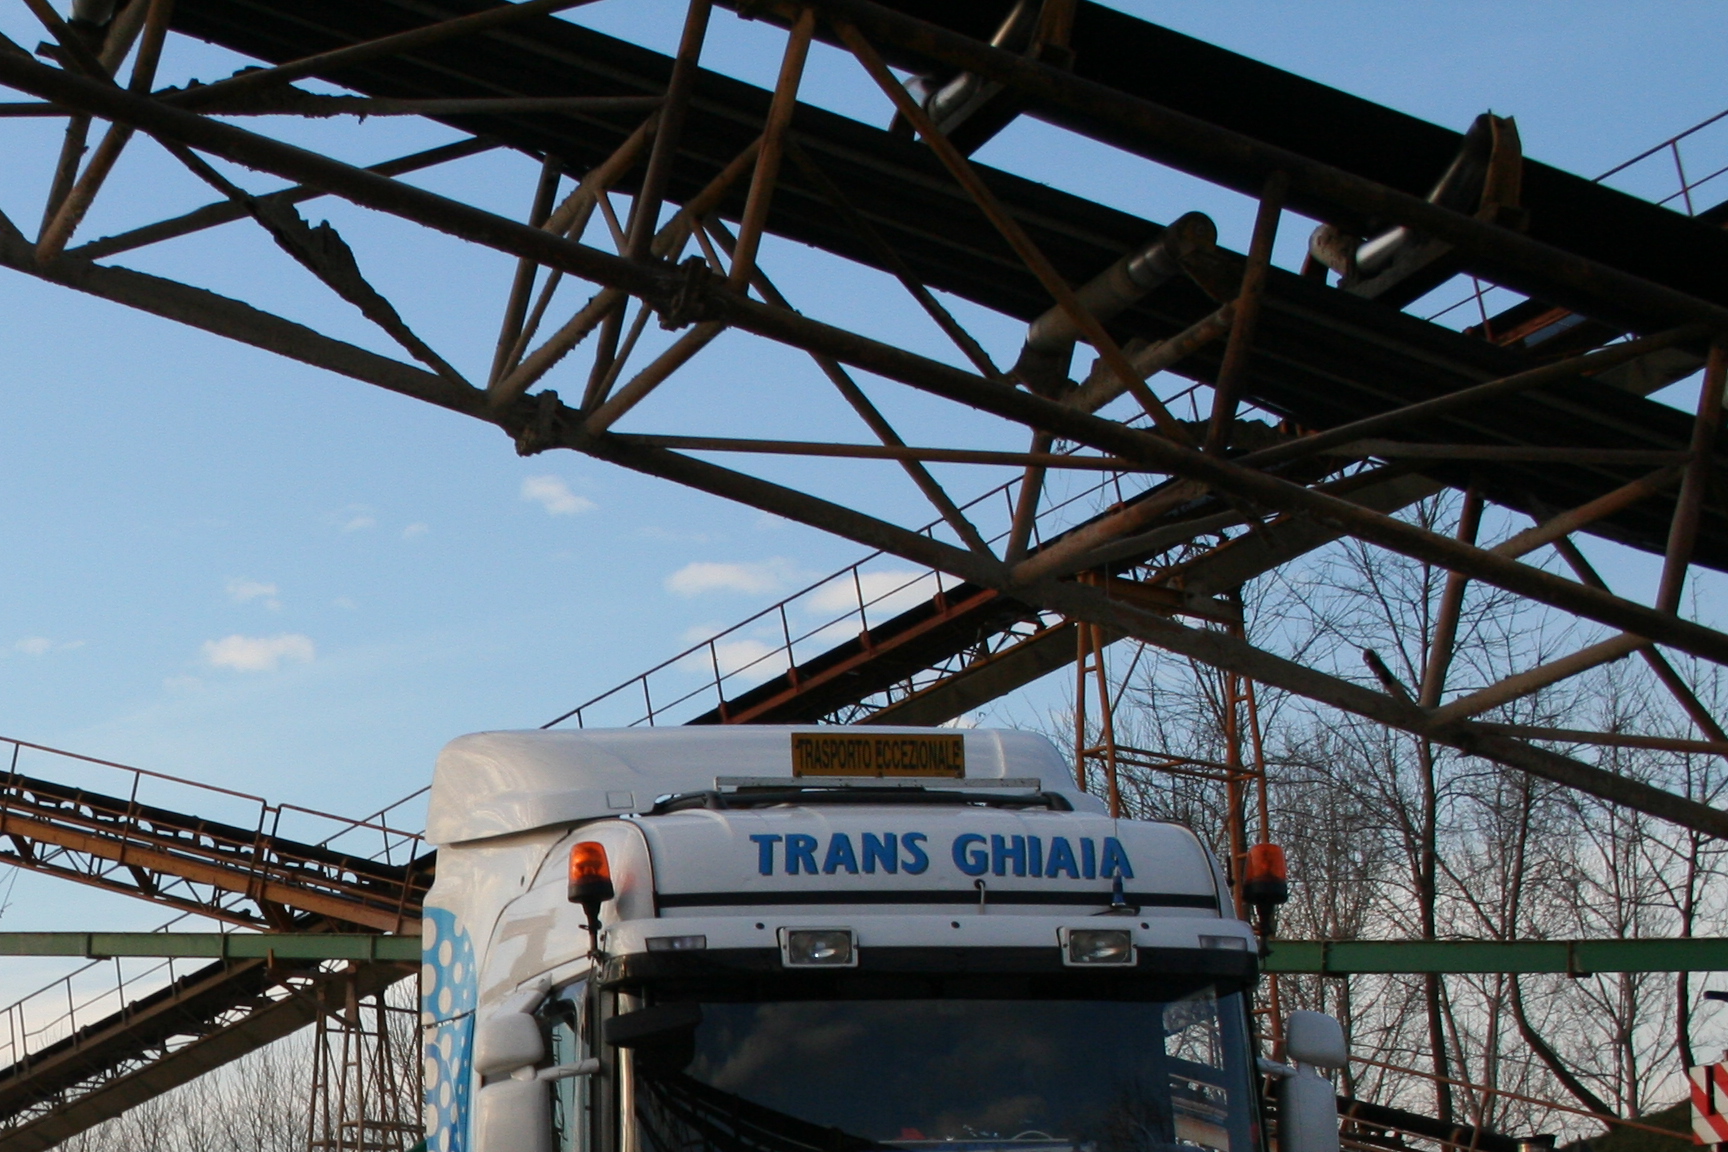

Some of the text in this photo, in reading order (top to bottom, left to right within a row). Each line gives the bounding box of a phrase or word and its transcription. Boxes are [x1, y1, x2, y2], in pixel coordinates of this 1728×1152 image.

[797, 738, 961, 770] TRASPORTO ECCEZIONALE
[749, 832, 1134, 879] TRANS GHIAIA
